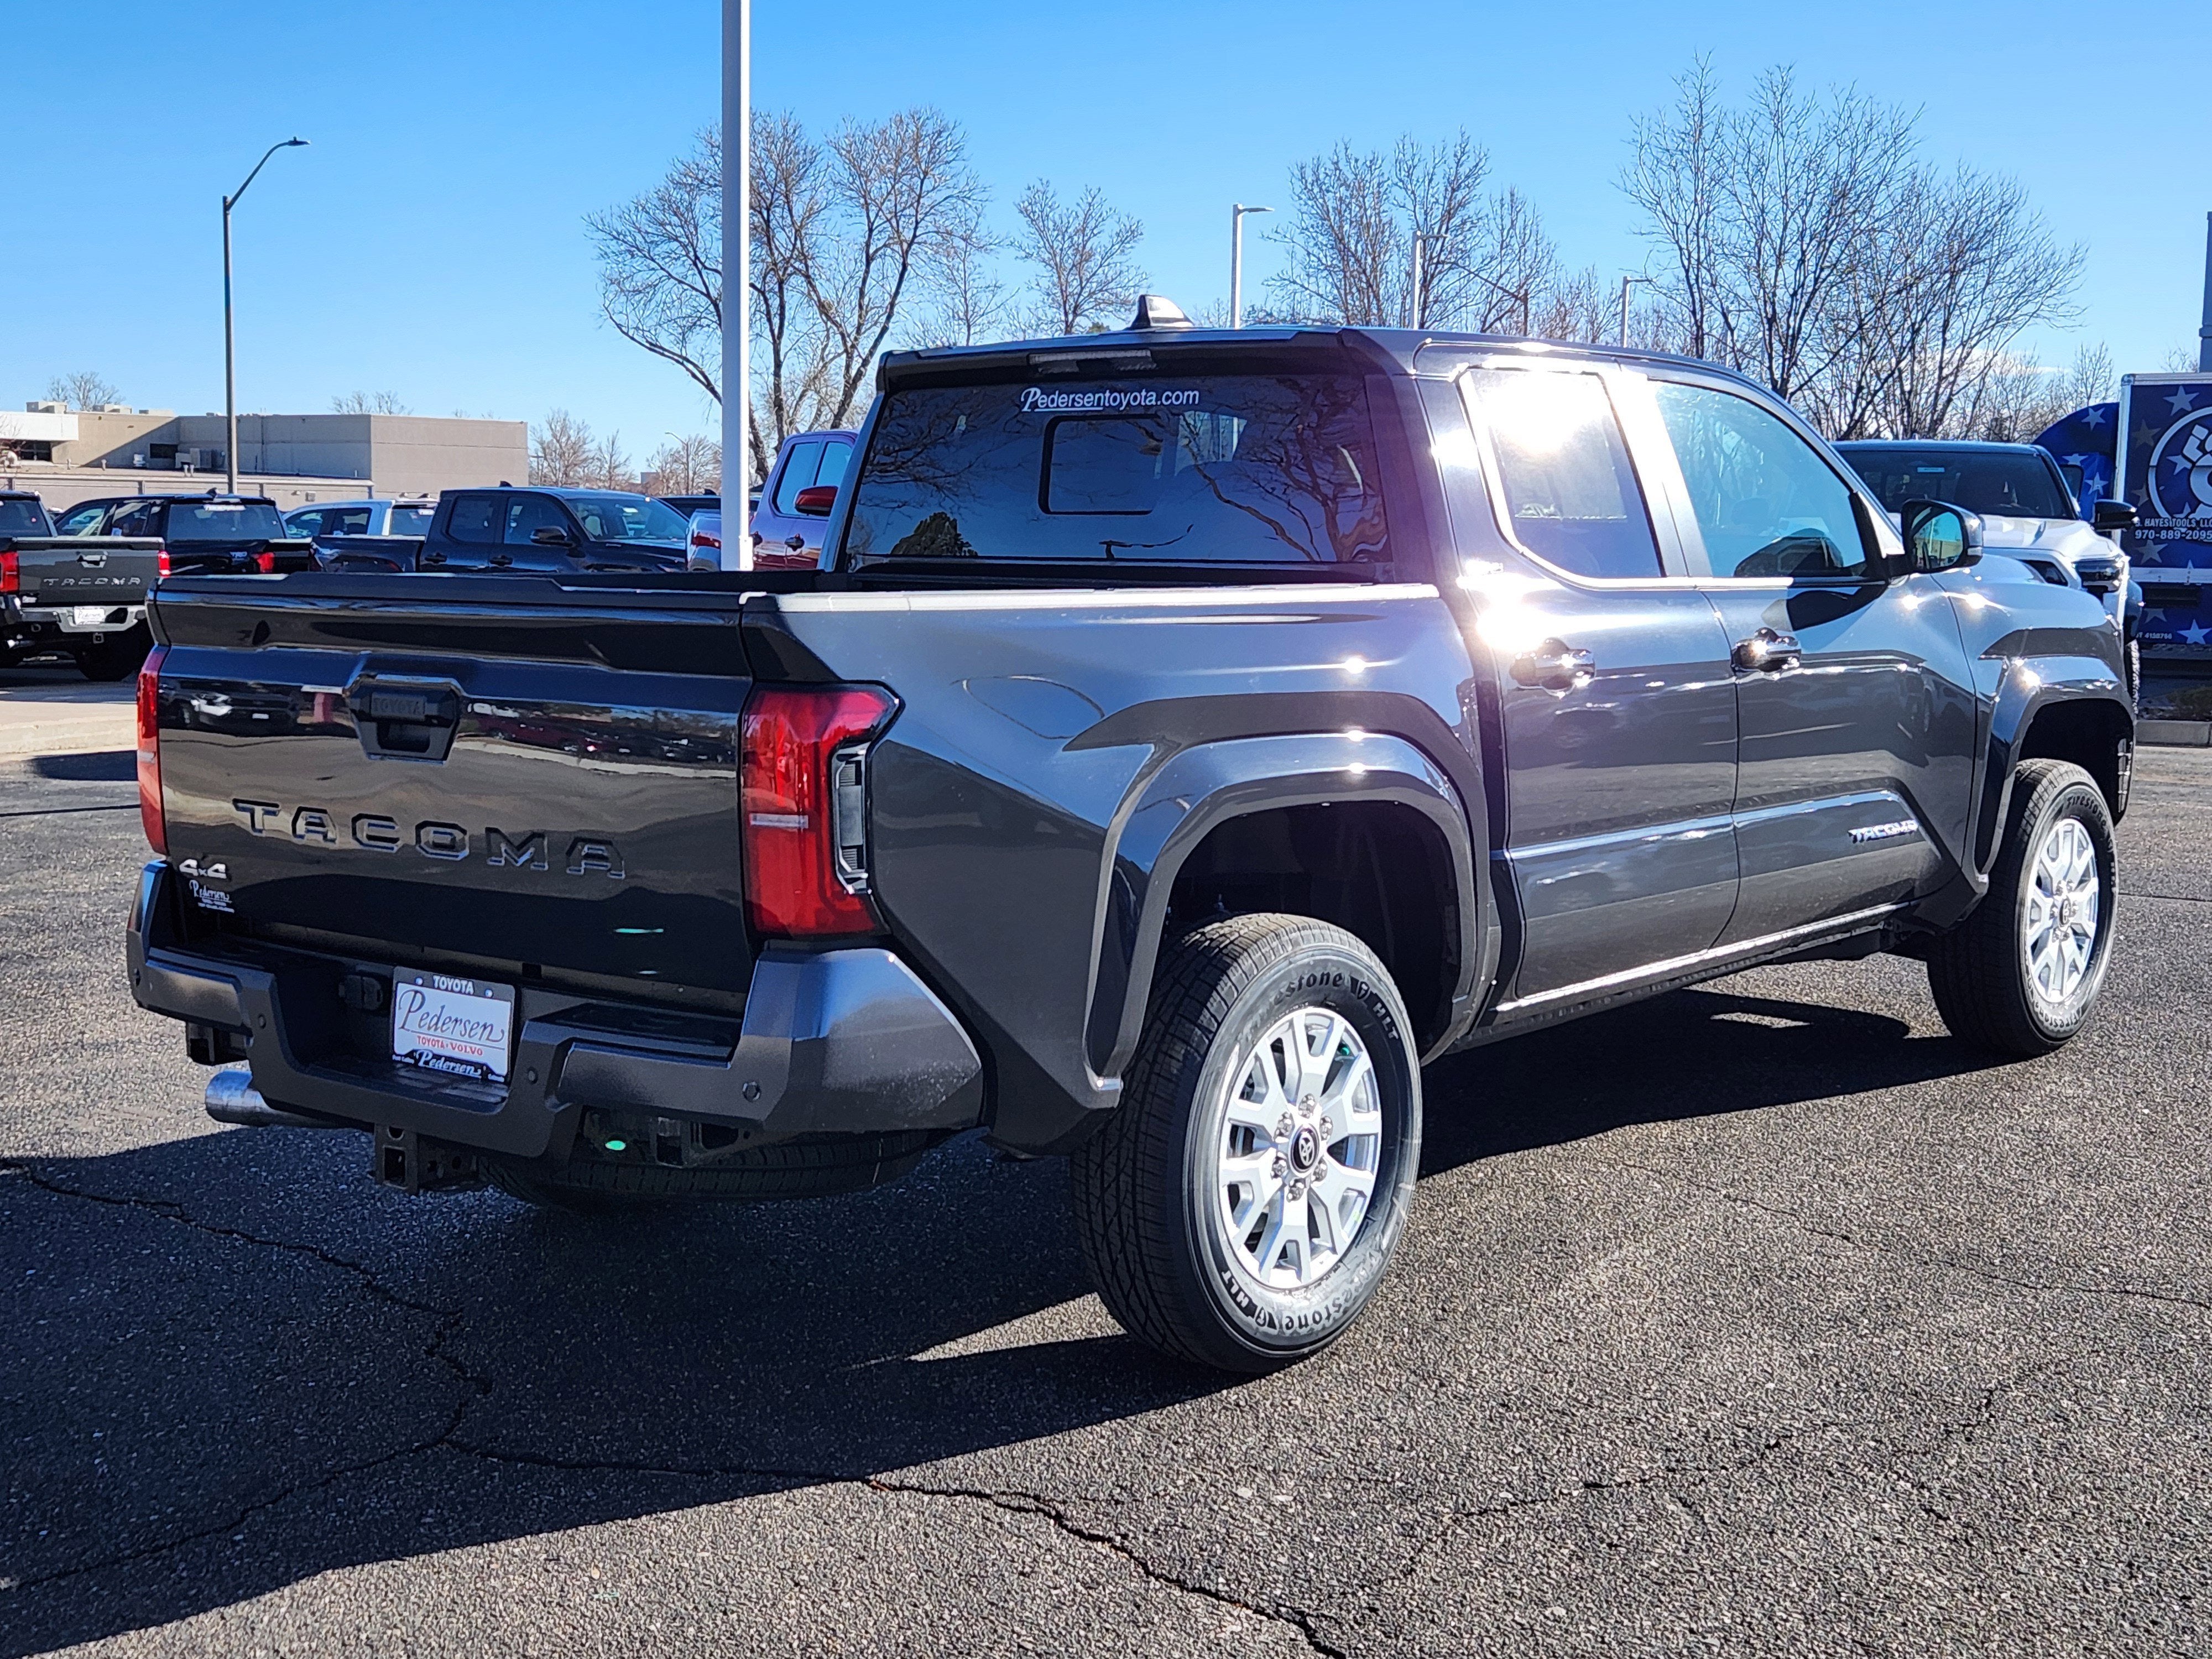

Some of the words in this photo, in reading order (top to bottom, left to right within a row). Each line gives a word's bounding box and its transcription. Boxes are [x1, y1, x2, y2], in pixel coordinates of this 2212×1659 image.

[1020, 387, 1199, 411] Pedersentoyota.com
[2171, 518, 2196, 527] TOOLS
[2135, 529, 2212, 540] 970-889-2095
[43, 577, 141, 586] TACOMA
[373, 697, 425, 716] TOYOTA
[232, 798, 625, 879] TACOMA
[432, 975, 474, 995] TOYOTA
[398, 989, 505, 1042] Pedersen
[417, 1035, 445, 1050] TOYOTA
[450, 1042, 483, 1056] VOLVO
[416, 1050, 481, 1078] Pedersen
